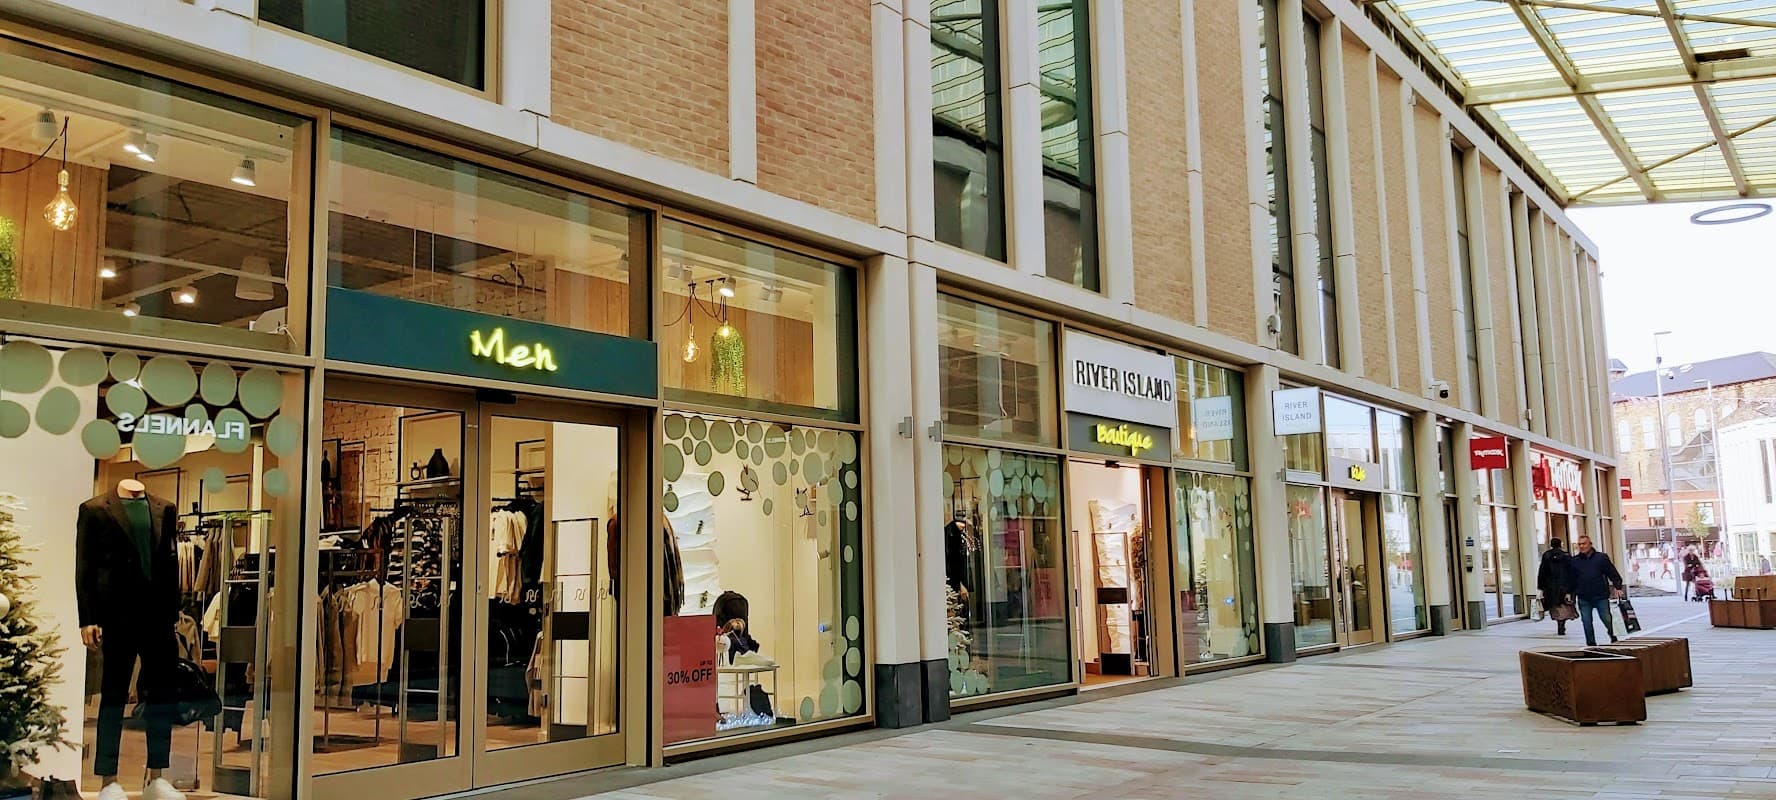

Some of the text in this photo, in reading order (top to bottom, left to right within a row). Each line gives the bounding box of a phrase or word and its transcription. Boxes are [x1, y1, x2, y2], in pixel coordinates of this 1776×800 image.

[470, 328, 558, 371] Men
[1074, 360, 1172, 403] RIVER ISLAND
[1282, 412, 1312, 421] ISLAND
[1285, 401, 1308, 409] RIVER
[1097, 423, 1153, 456] Boutique
[667, 668, 712, 685] 30% OFF
